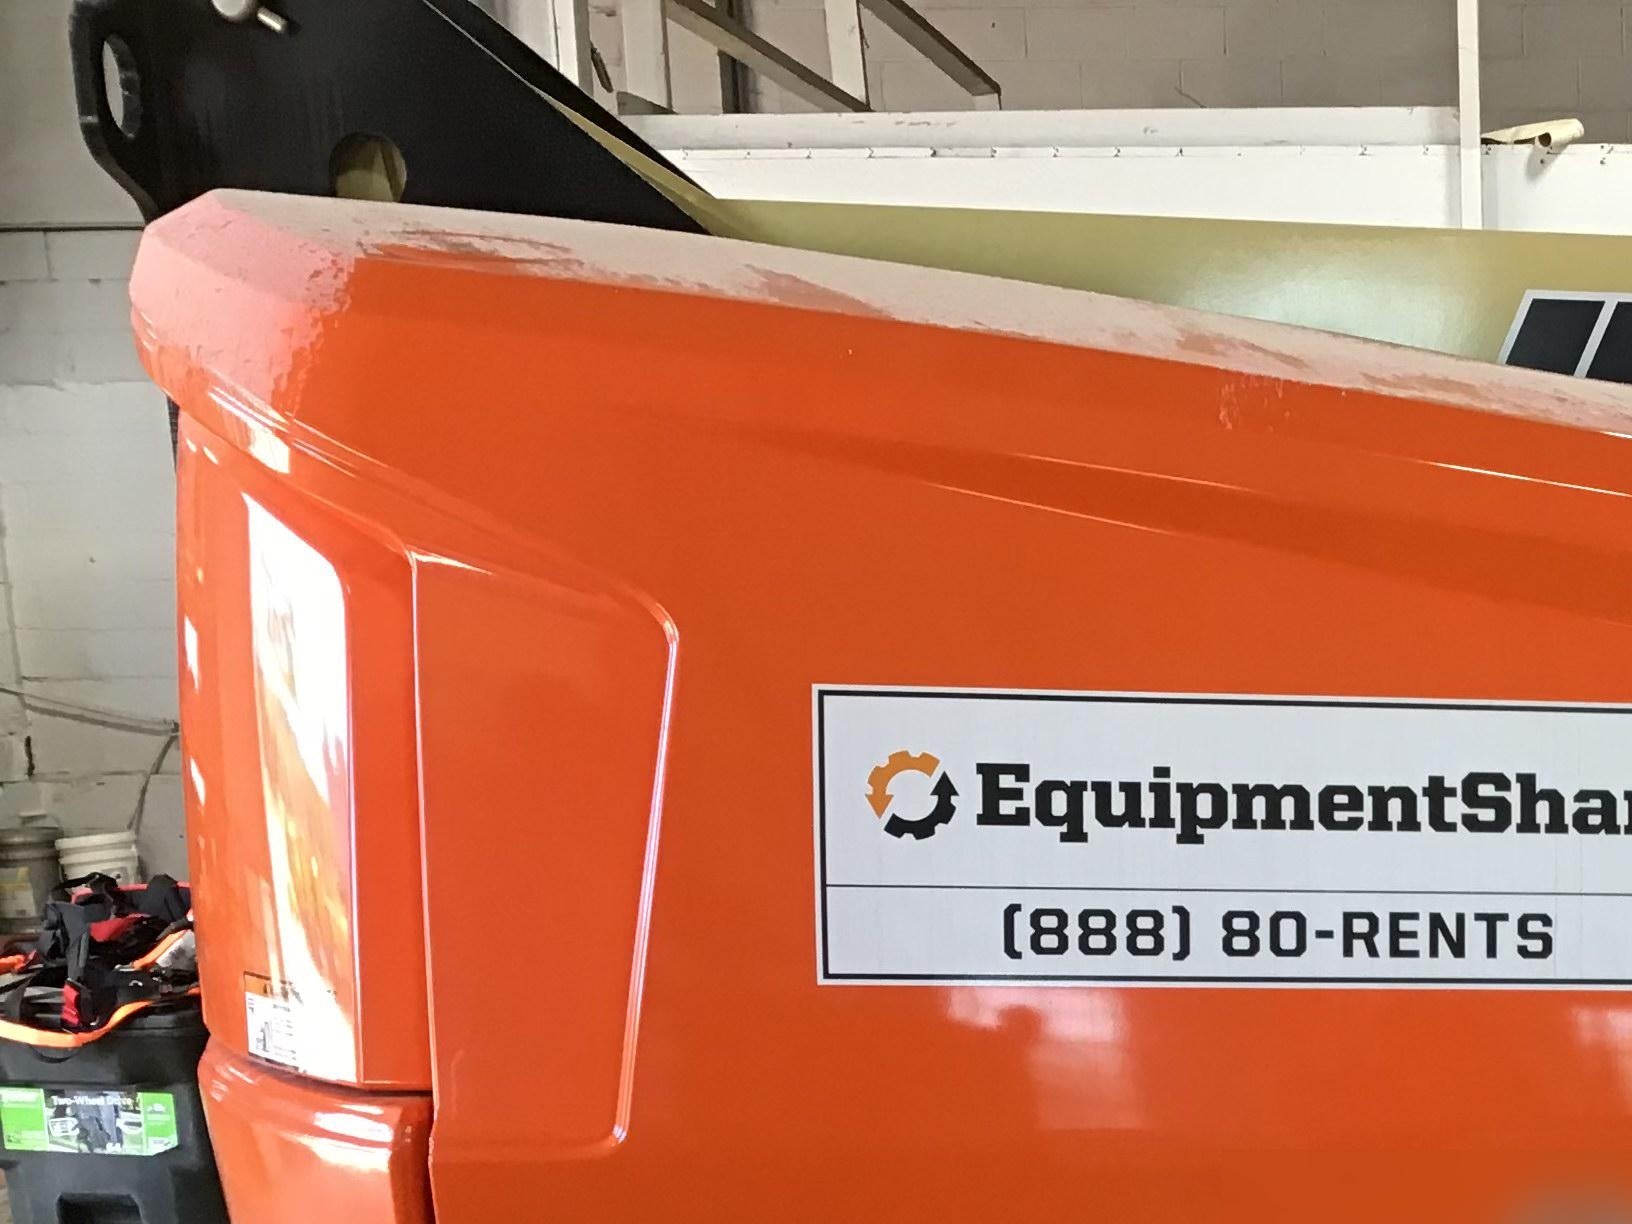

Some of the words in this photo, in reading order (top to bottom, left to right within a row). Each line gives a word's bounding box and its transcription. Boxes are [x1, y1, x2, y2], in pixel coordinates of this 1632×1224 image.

[1003, 903, 1191, 960] (888)
[1221, 910, 1555, 961] 80-RENTS
[53, 1095, 105, 1106] Two-Wheel
